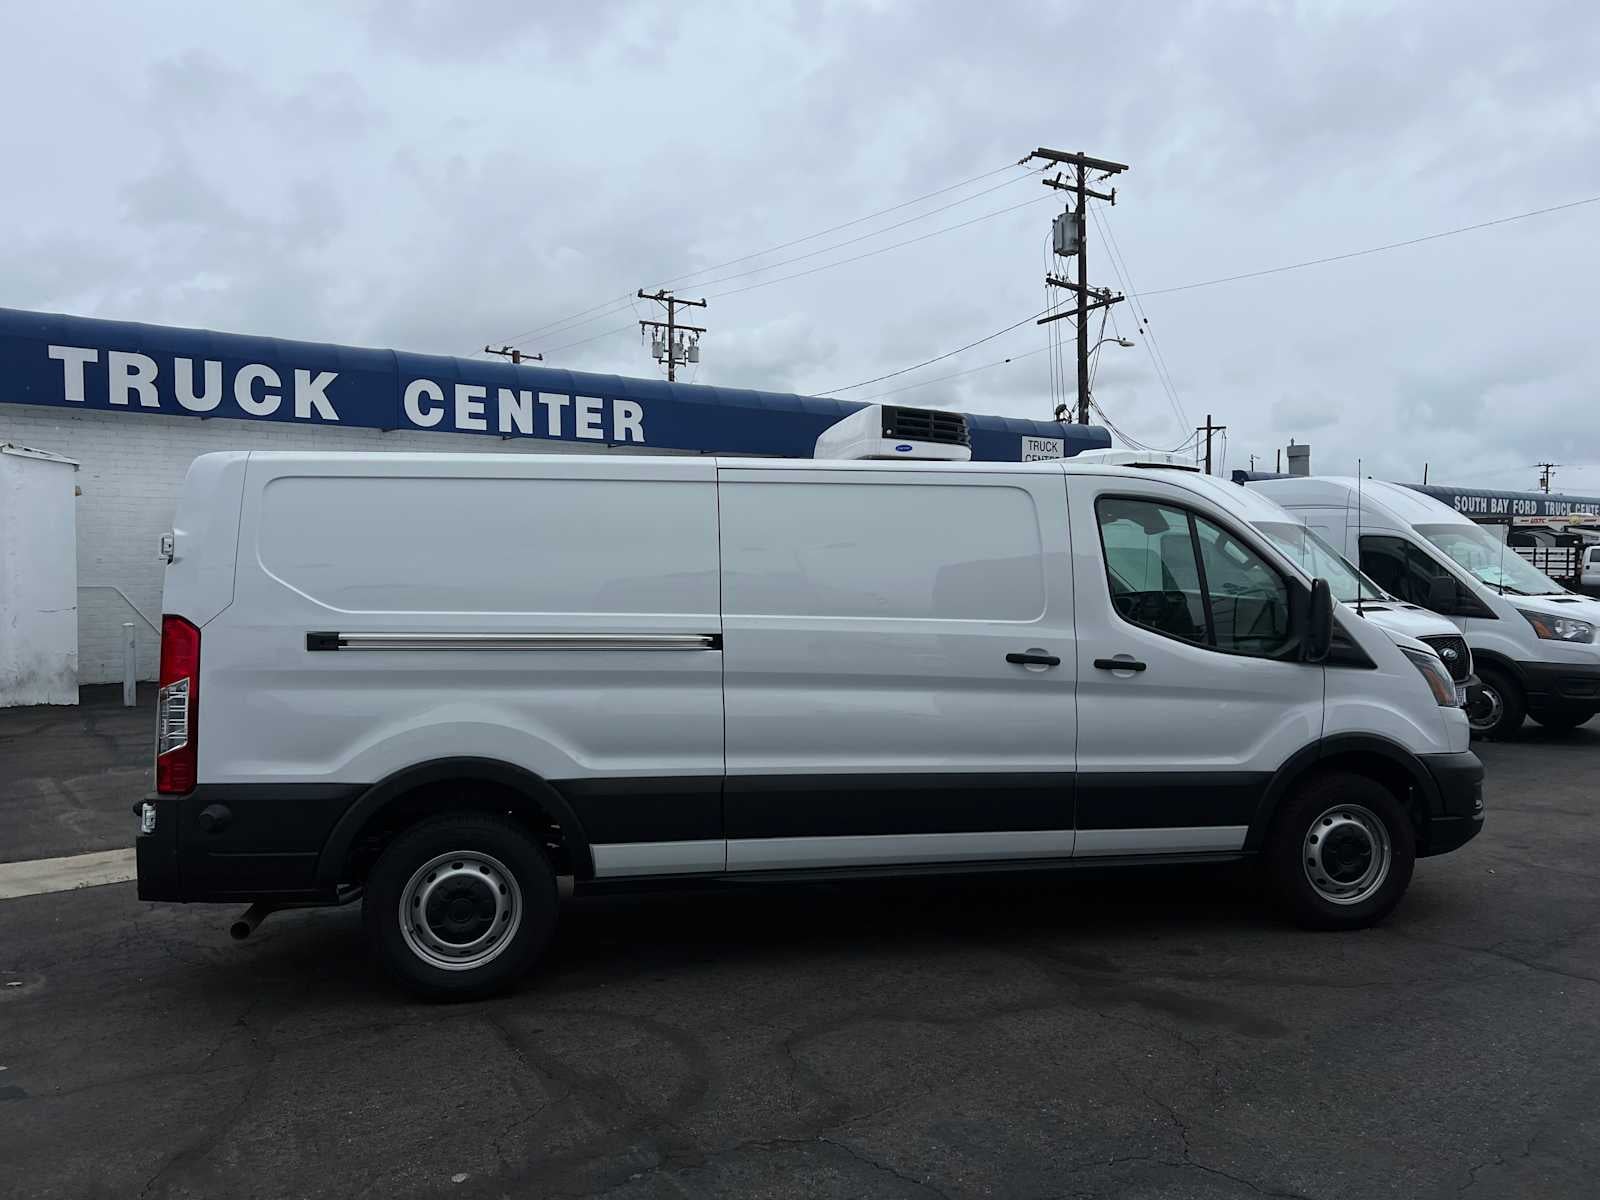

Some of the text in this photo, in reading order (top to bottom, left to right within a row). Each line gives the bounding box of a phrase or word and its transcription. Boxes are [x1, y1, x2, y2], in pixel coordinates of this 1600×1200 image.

[48, 345, 645, 443] TRUCK CENTER
[1028, 440, 1057, 452] TRUCK
[1454, 496, 1487, 512] SOUTH
[1491, 498, 1509, 513] BAY
[1513, 499, 1537, 515] FORD
[1544, 501, 1571, 516] TRUCK
